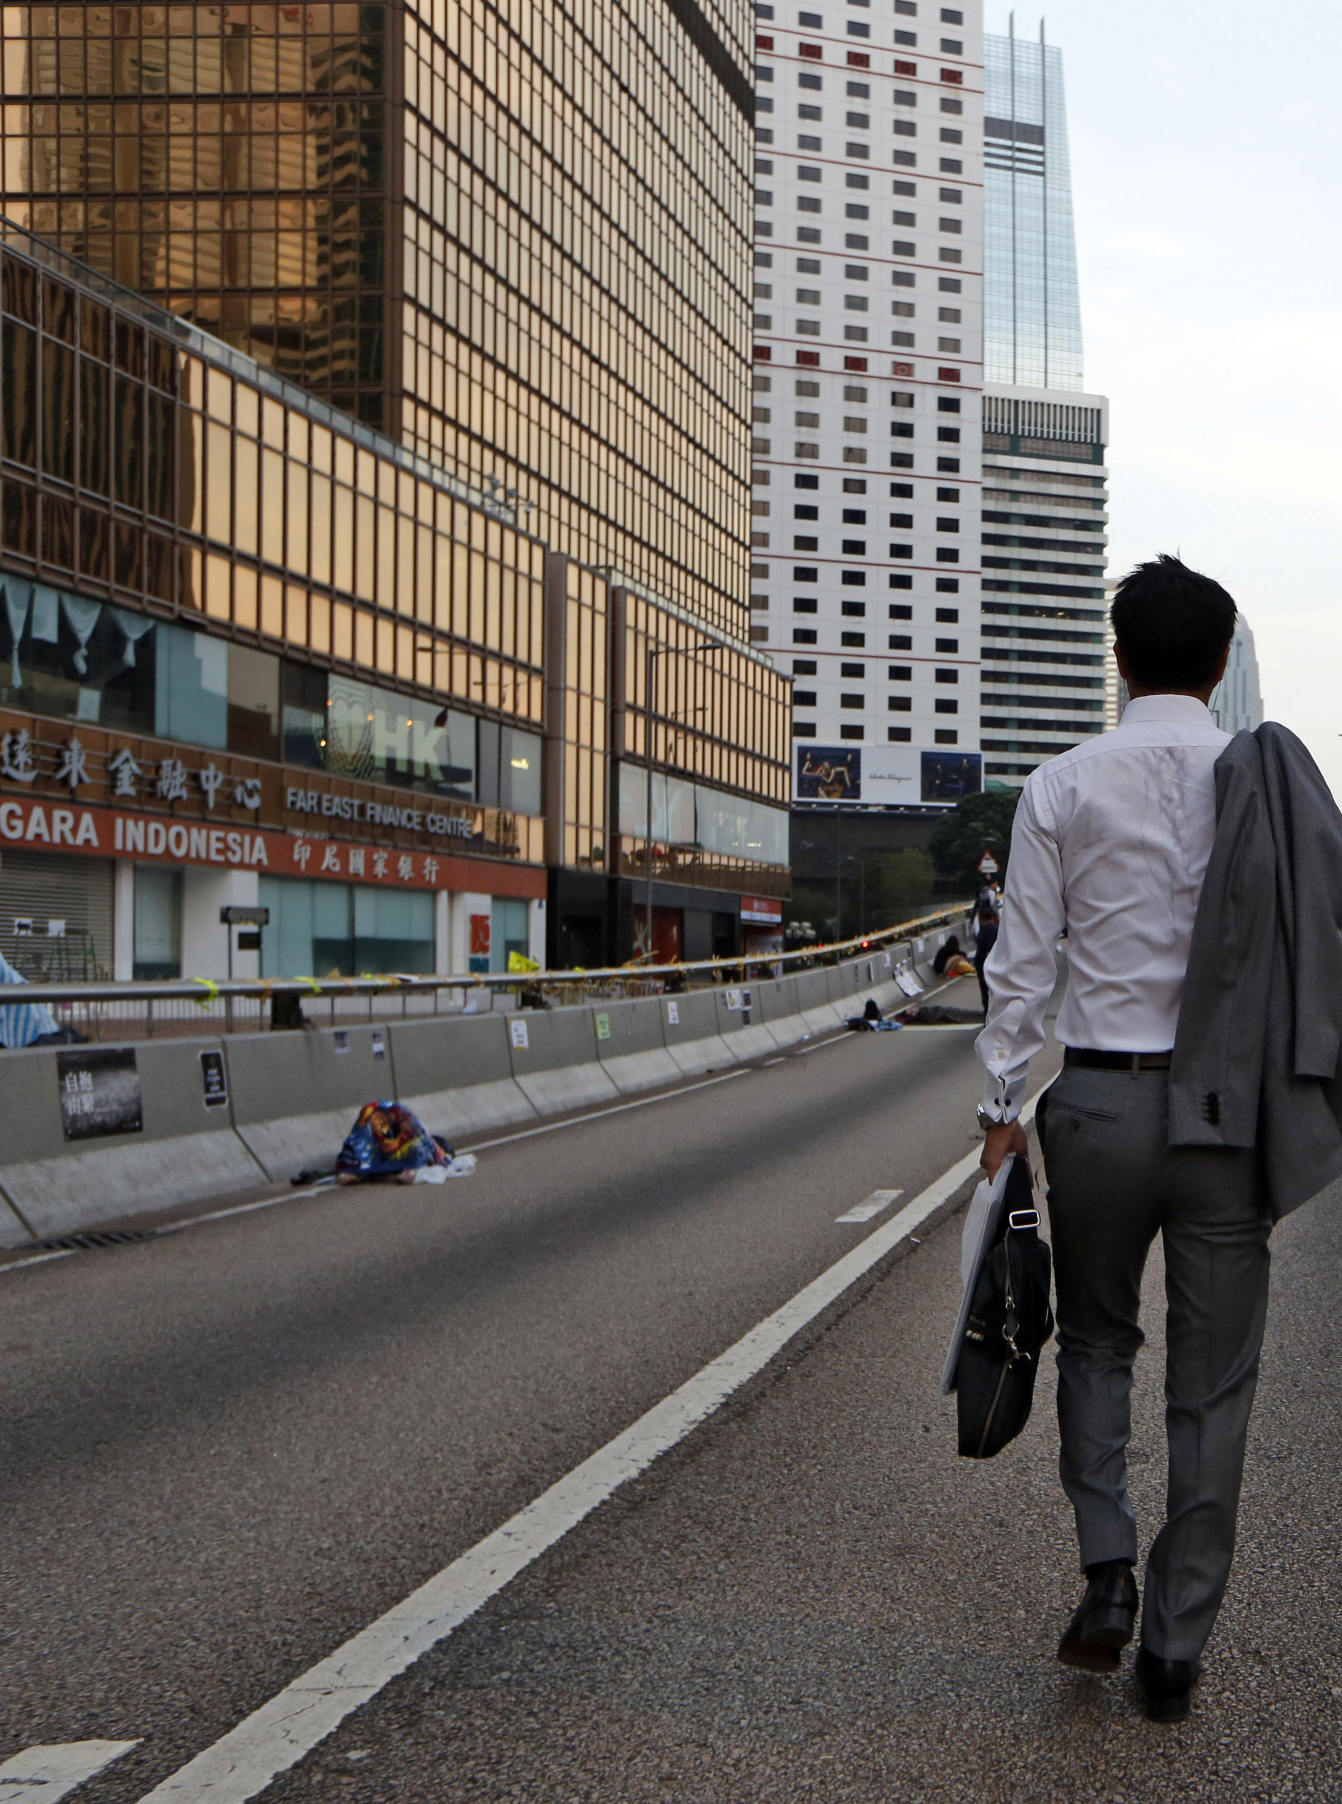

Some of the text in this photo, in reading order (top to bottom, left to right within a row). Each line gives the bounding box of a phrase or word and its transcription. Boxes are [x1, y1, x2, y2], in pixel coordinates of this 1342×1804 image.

[1, 728, 262, 809] 遠東金融中心
[0, 802, 269, 867] GARA INDONESIA
[286, 787, 474, 839] FAR EAST FINANCE CENTRE
[292, 839, 440, 884] 印尼國家銀行
